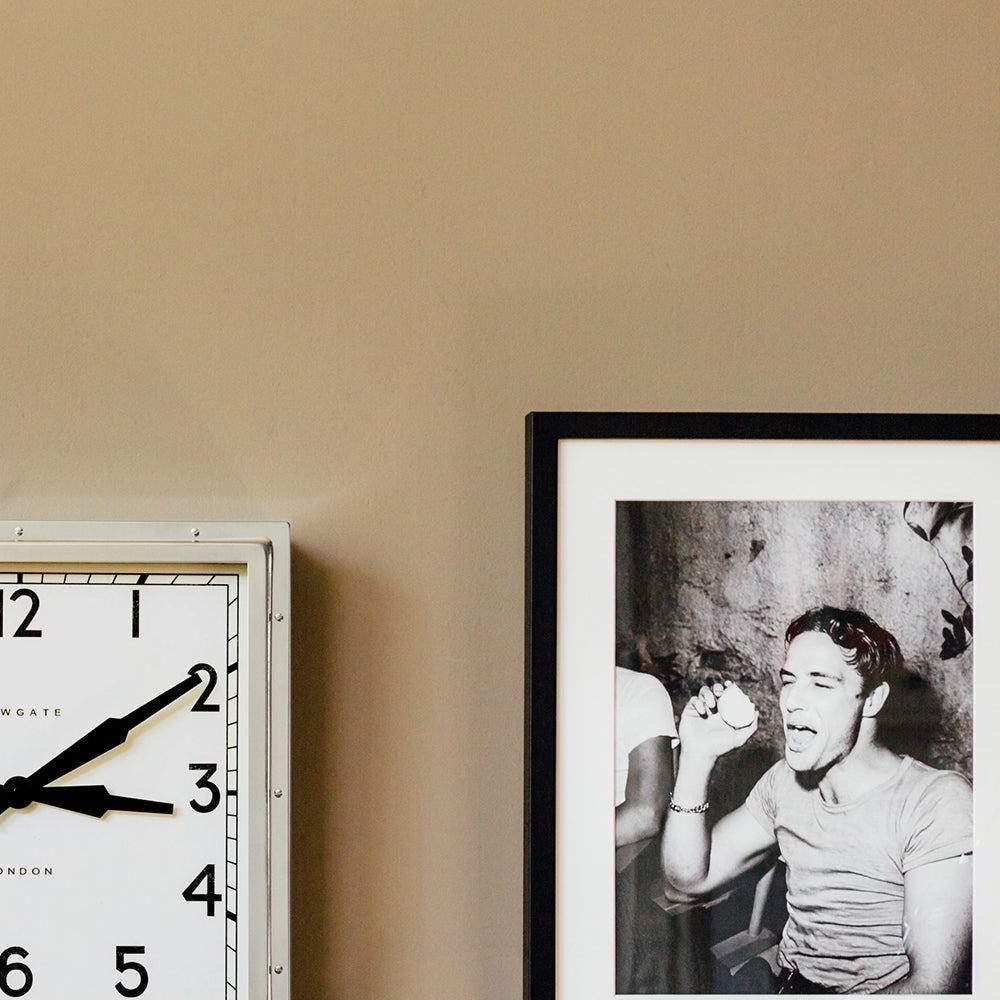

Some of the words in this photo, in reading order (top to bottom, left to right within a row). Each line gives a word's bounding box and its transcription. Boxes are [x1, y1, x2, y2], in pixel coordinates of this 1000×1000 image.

[131, 589, 140, 638] 1
[188, 662, 221, 713] 2
[188, 762, 221, 814] 3
[181, 863, 223, 917] 4
[114, 945, 149, 998] 5
